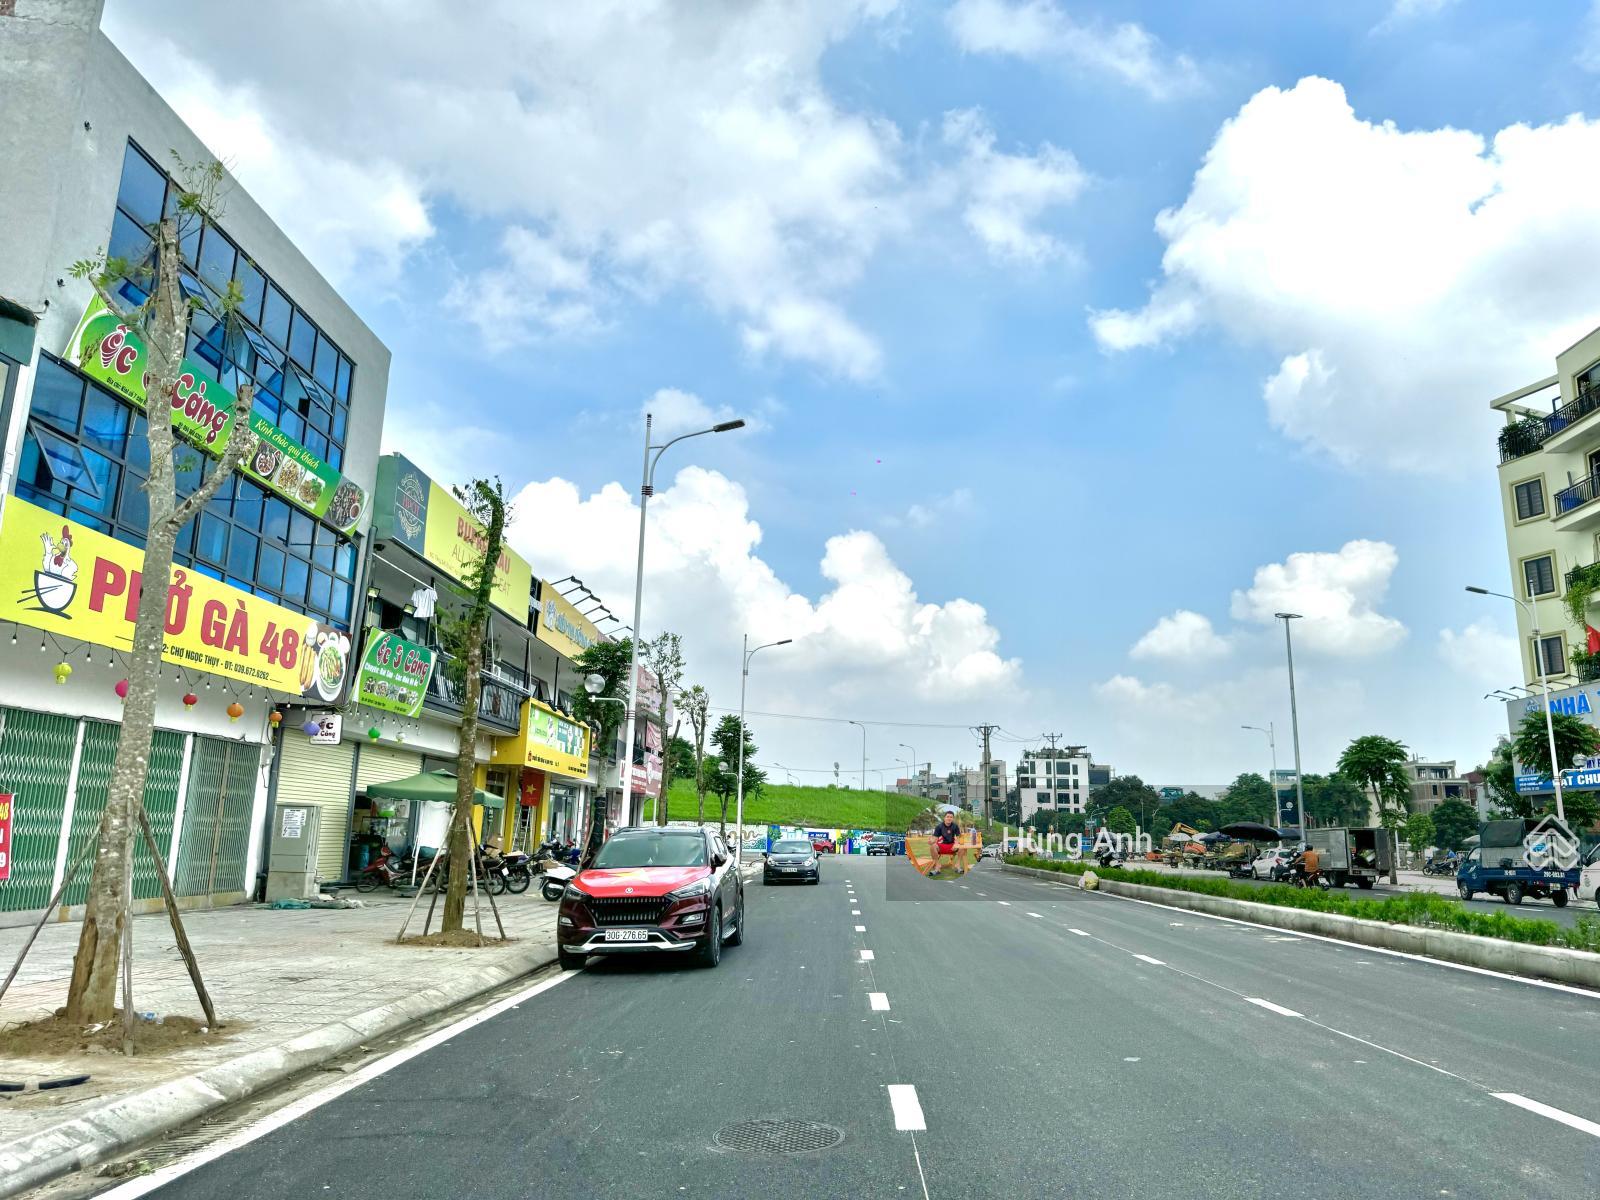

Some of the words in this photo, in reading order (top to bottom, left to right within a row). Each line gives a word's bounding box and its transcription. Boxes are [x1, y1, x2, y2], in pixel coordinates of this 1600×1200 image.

[272, 433, 289, 448] chào
[301, 451, 320, 470] khách
[200, 599, 249, 657] GÀ
[259, 621, 300, 670] 48
[170, 645, 184, 660] CHỢ
[185, 650, 204, 664] NGỌC
[392, 644, 404, 669] 3
[606, 930, 647, 940] 30G-276.65
